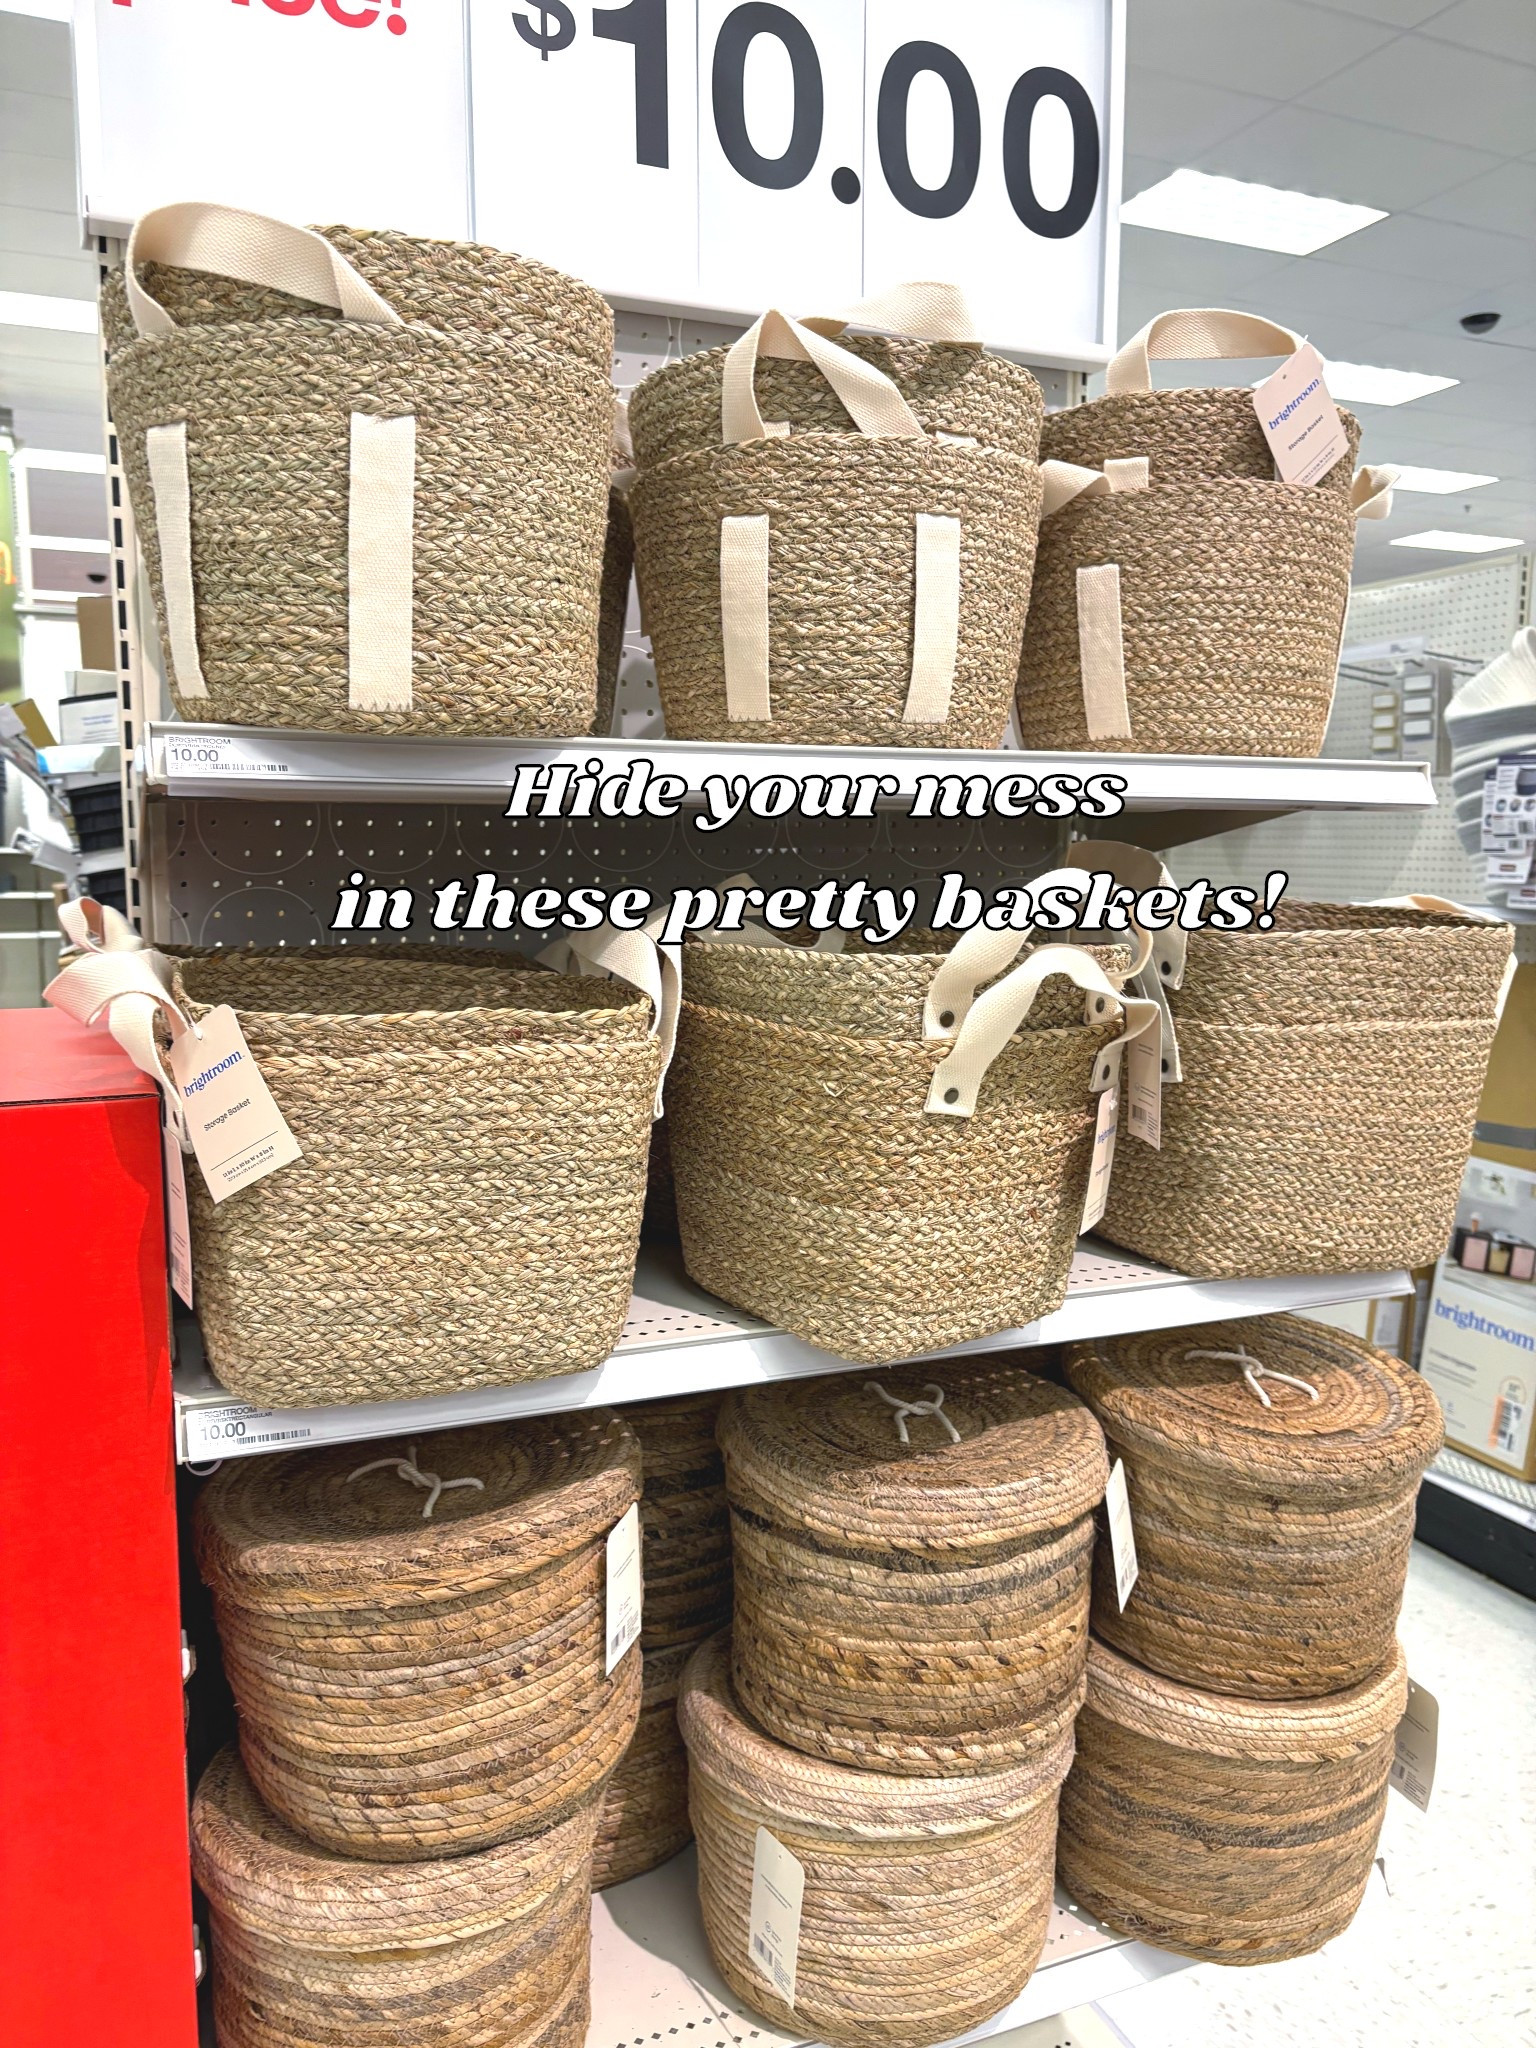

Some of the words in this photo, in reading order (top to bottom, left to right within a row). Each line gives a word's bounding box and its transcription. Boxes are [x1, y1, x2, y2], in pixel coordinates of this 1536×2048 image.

[1268, 378, 1321, 431] brightroom
[171, 748, 219, 762] 10.00
[183, 1050, 243, 1098] brightroom
[203, 1112, 228, 1132] Storage
[227, 1098, 251, 1116] Basket
[1434, 1297, 1535, 1352] brightroom
[200, 1421, 246, 1441] 10.00
